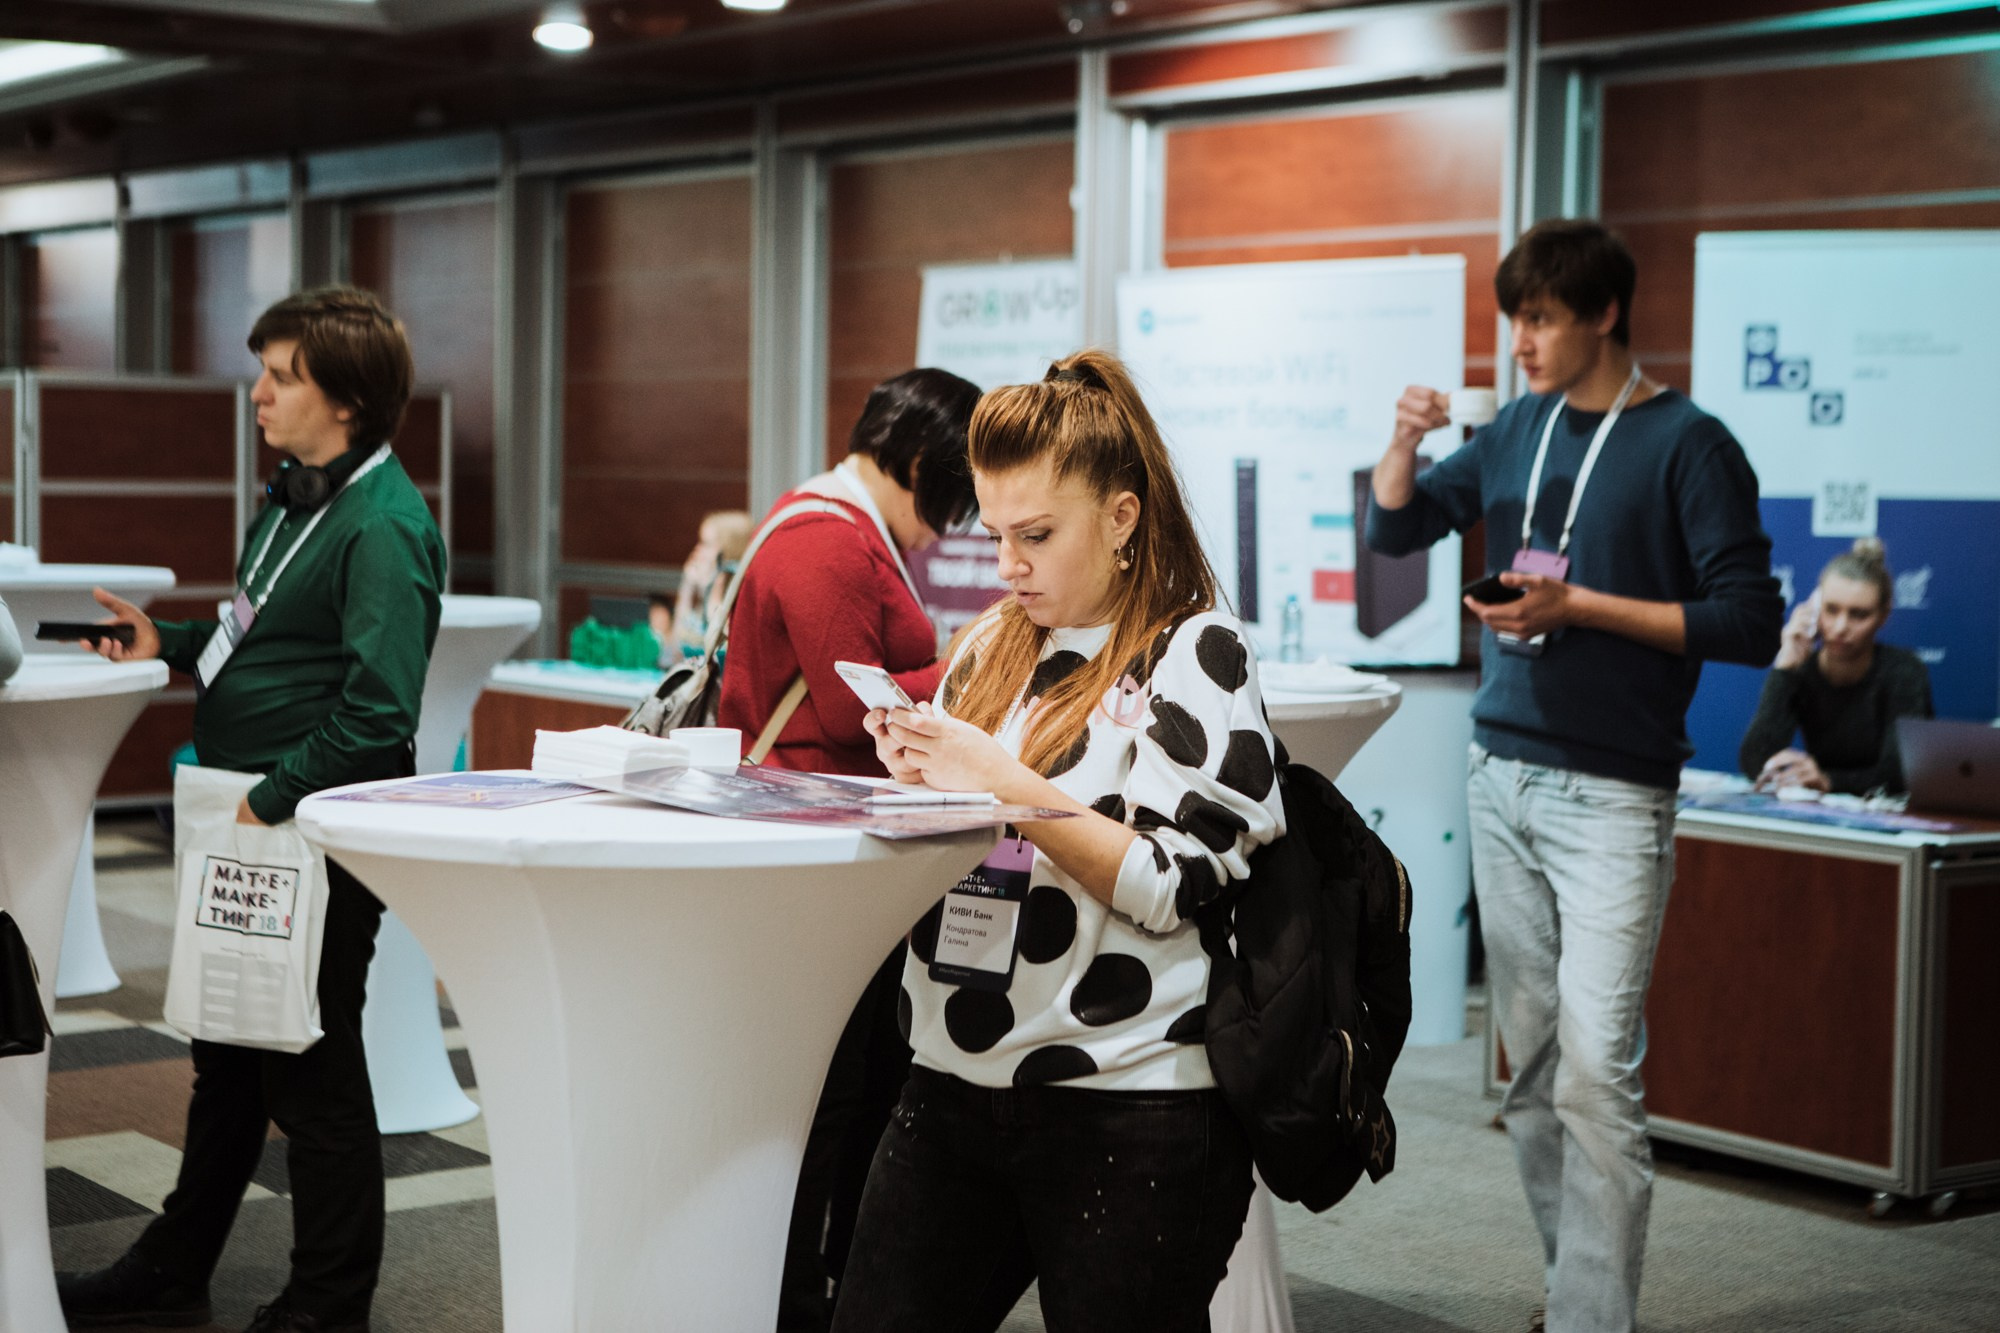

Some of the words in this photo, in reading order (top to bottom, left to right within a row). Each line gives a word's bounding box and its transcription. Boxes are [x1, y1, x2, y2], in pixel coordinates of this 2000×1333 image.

[949, 905, 972, 918] КИВИ
[973, 910, 993, 921] Банк
[946, 924, 987, 937] Кондратова
[944, 936, 969, 947] Галина
